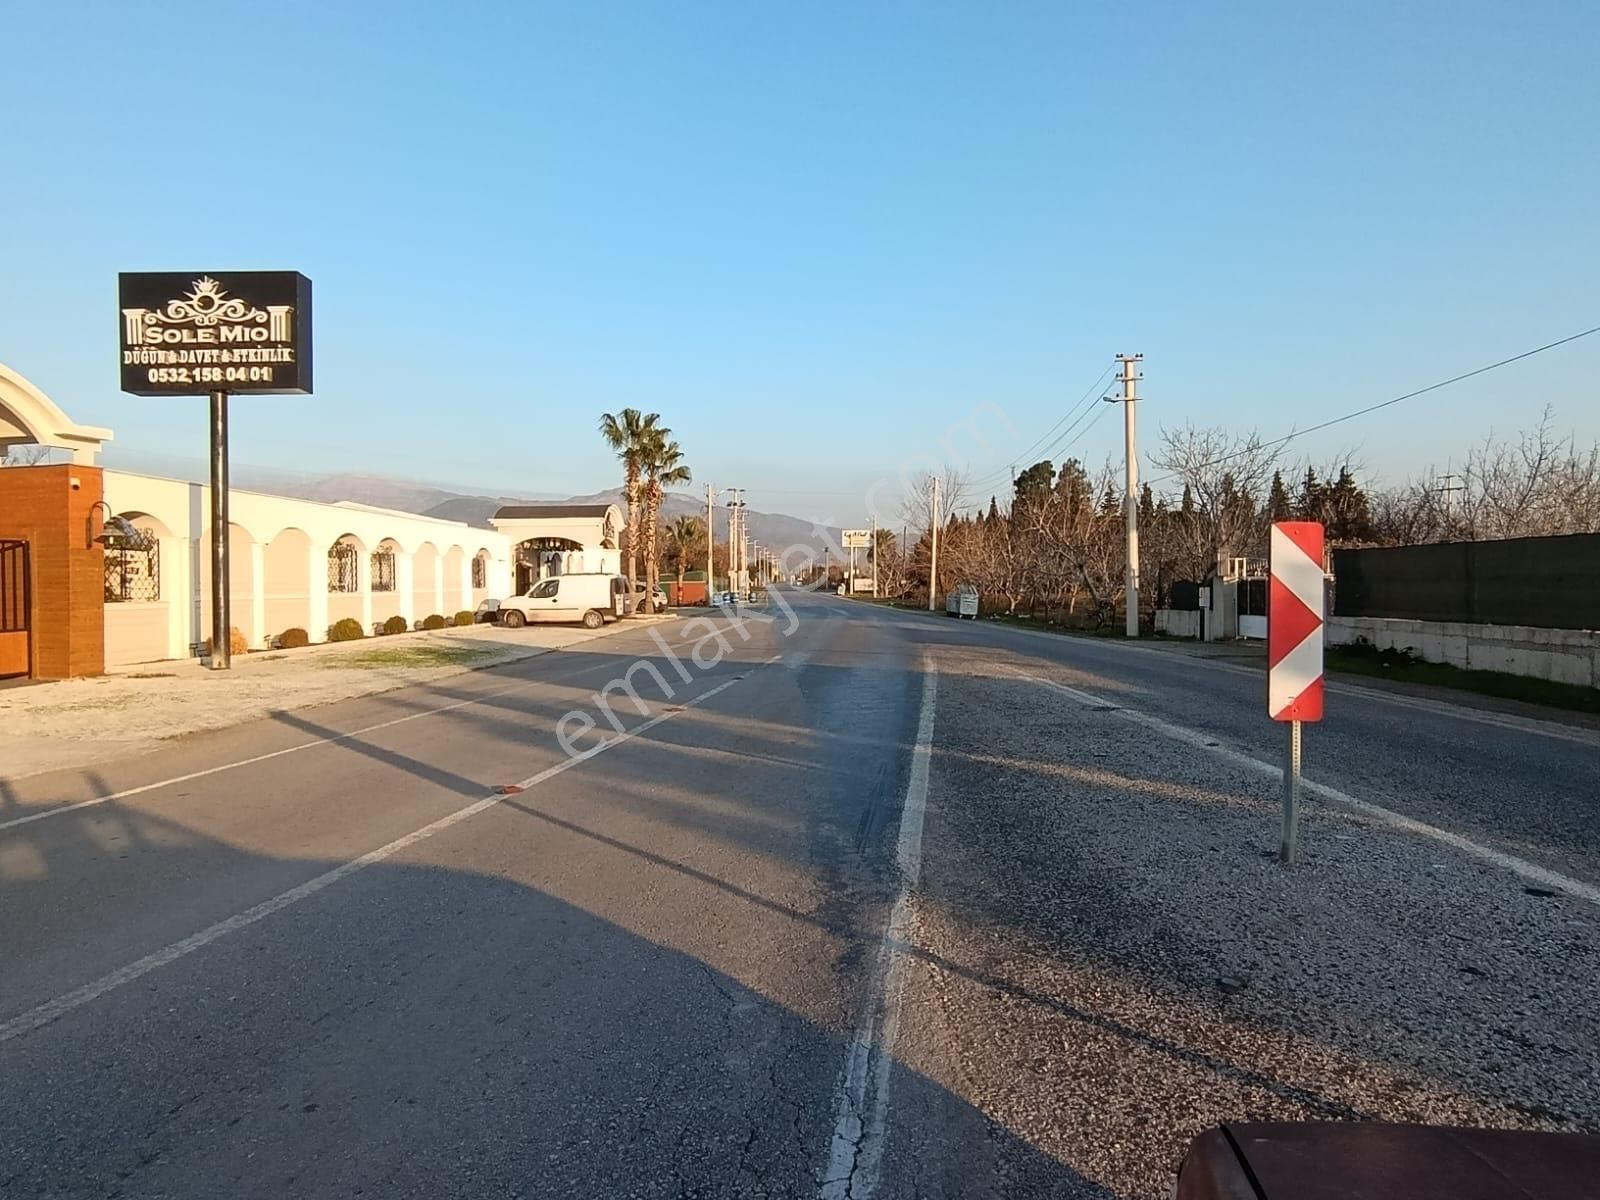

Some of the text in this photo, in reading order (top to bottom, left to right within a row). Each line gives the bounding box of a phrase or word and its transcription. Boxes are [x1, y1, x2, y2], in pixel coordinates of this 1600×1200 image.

[179, 349, 220, 364] DAVET
[231, 344, 294, 363] ETKİNLİK
[148, 366, 271, 384] 0532 158 04 01
